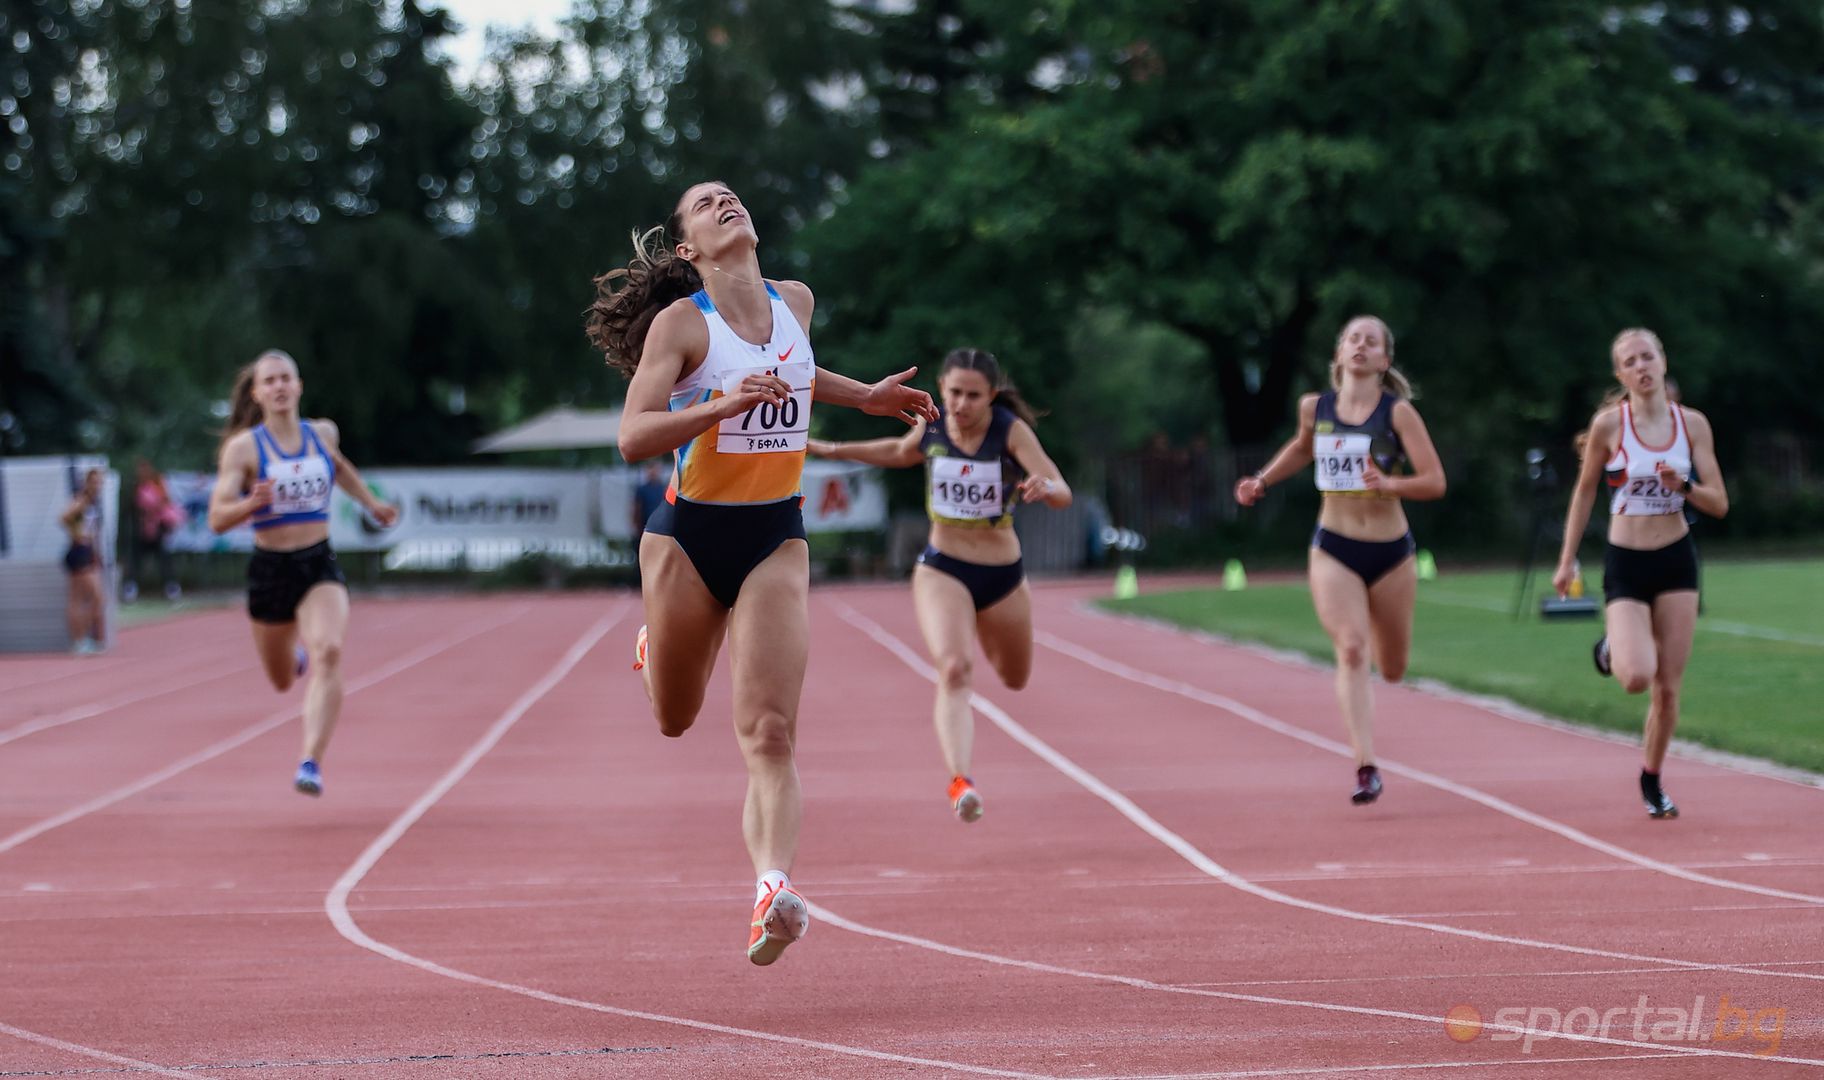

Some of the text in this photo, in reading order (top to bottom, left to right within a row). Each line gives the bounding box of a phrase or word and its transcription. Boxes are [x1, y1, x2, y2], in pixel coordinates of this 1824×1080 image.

[741, 396, 799, 431] 700
[757, 438, 789, 449] БФЛА
[1321, 457, 1364, 475] 1941
[938, 481, 997, 505] 1964
